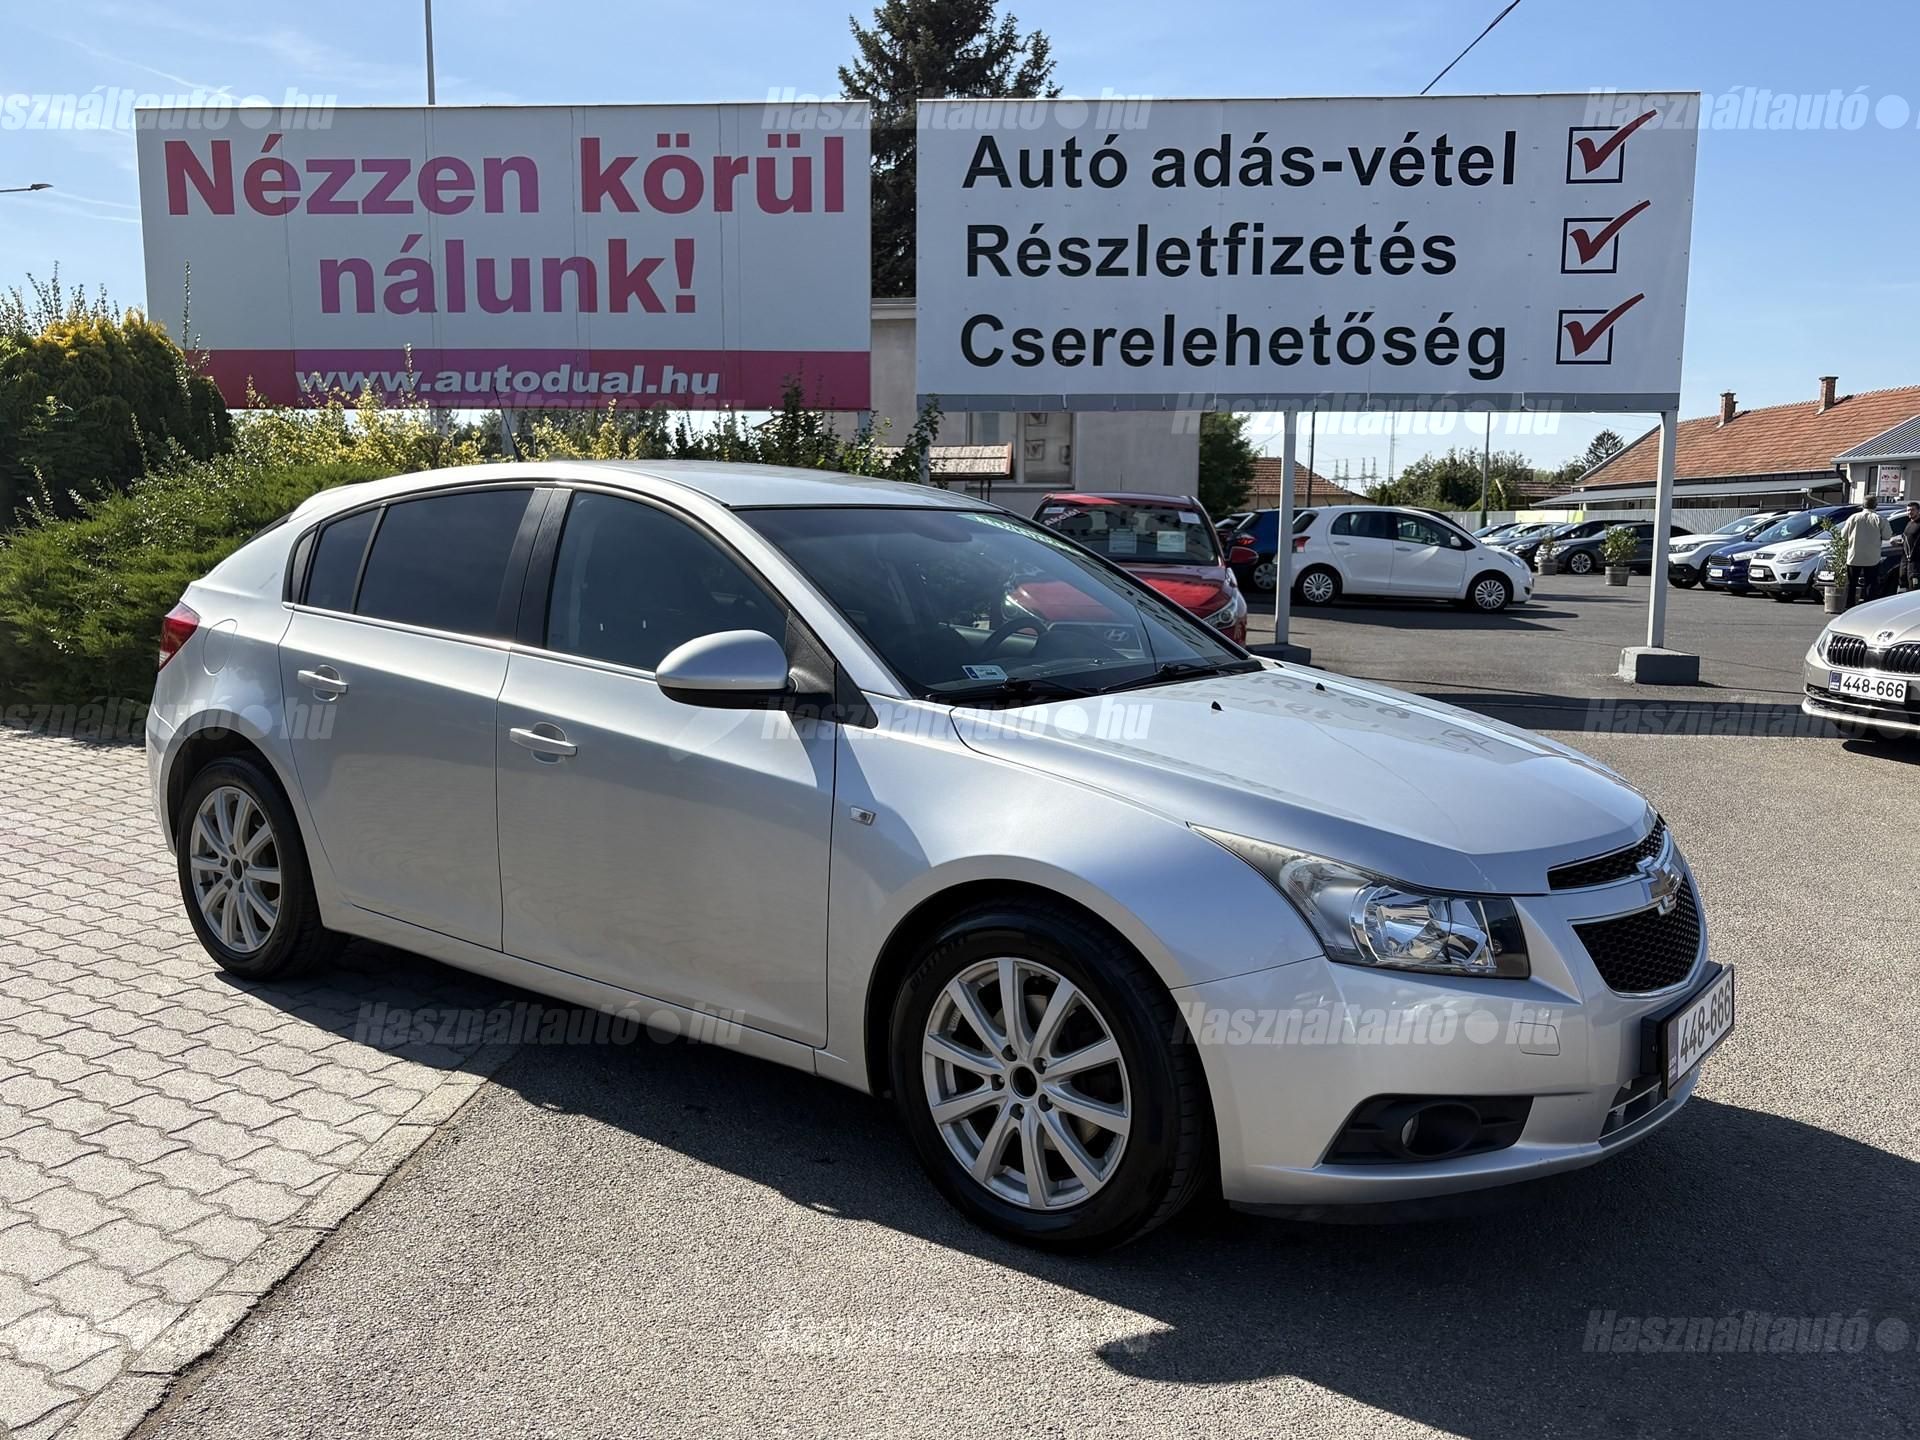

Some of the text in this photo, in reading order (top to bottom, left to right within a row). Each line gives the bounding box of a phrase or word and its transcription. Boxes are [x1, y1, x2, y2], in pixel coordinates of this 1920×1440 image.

[165, 133, 846, 217] Nézzen körül
[962, 130, 1518, 189] Autó adás-vétel
[319, 234, 697, 315] nálunk!
[966, 220, 1457, 278] Részletfizetés
[960, 311, 1507, 381] Cserelehetőség
[295, 364, 719, 395] www.autodual.hu
[1843, 676, 1904, 698] 448-666
[1681, 980, 1731, 1063] 448-666
